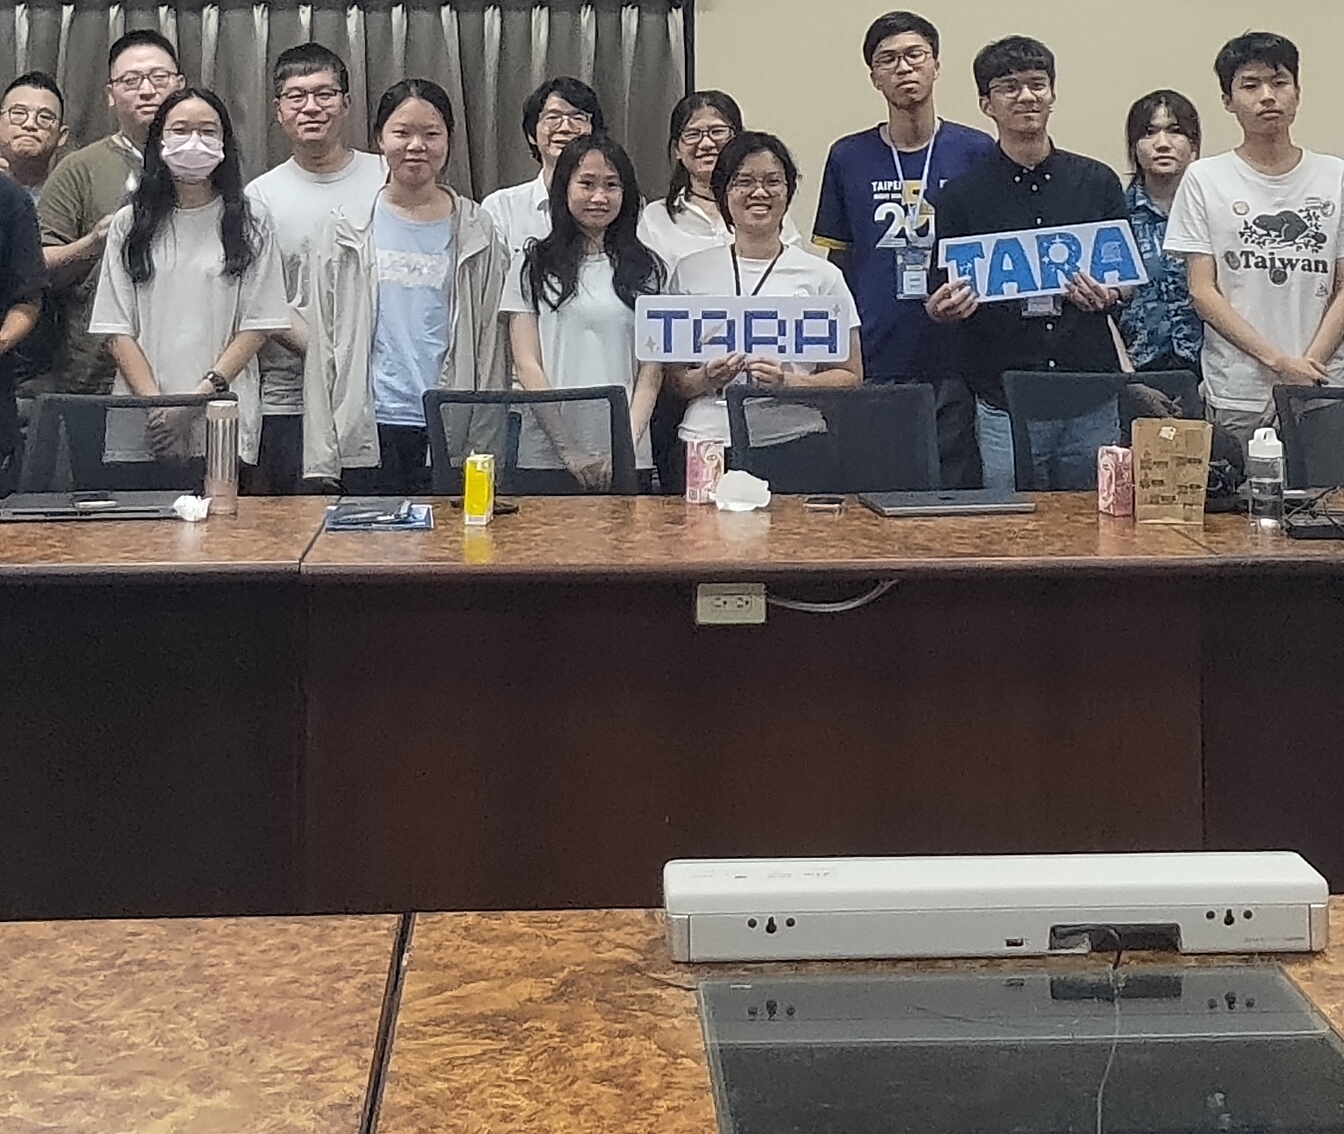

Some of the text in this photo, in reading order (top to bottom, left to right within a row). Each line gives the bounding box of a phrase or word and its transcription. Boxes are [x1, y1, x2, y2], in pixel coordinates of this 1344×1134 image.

[946, 227, 1141, 297] TARA
[1239, 250, 1329, 277] Taiwan
[646, 309, 838, 354] TARA
